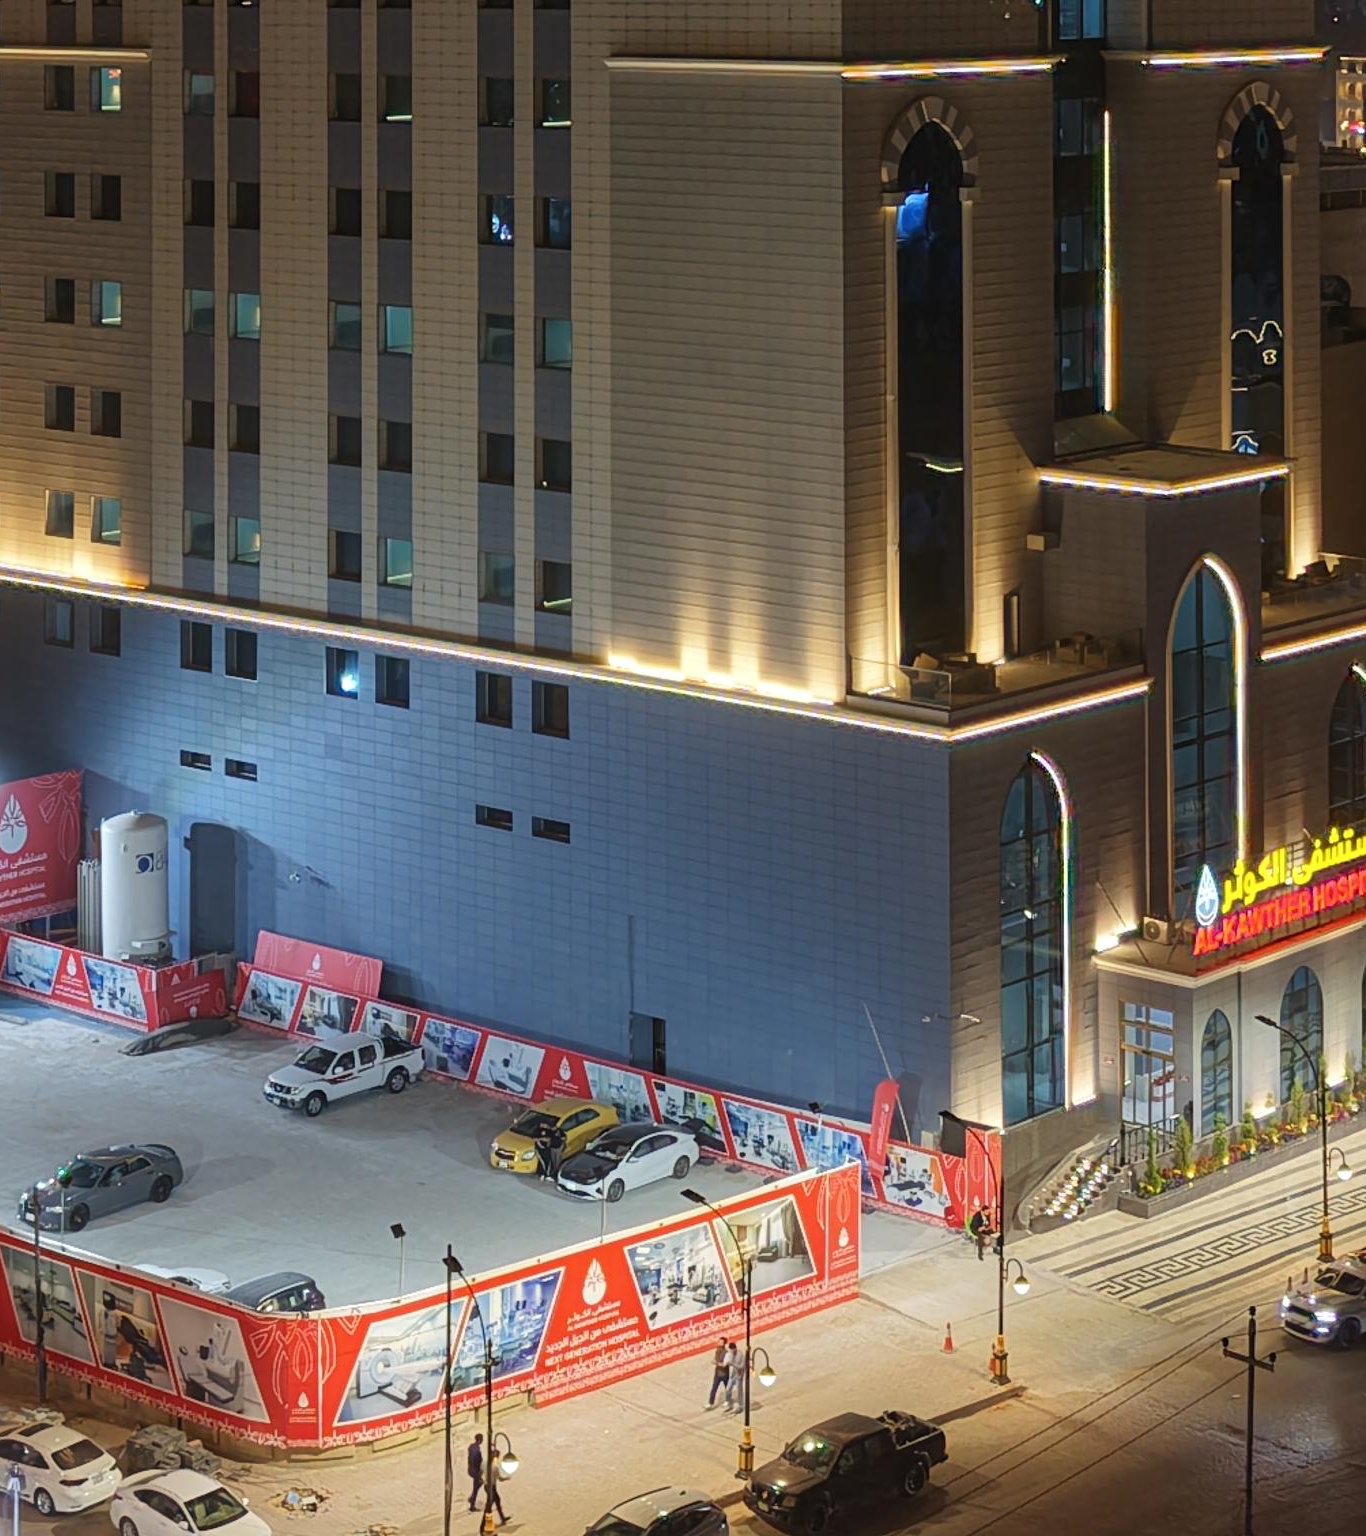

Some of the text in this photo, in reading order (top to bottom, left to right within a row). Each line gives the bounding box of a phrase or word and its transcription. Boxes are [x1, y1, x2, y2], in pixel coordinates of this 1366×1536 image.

[1221, 848, 1286, 914] الكوثر
[1193, 890, 1312, 956] AL-KAWTHER
[545, 1328, 640, 1367] NEXT GENERATION HOSPITAL
